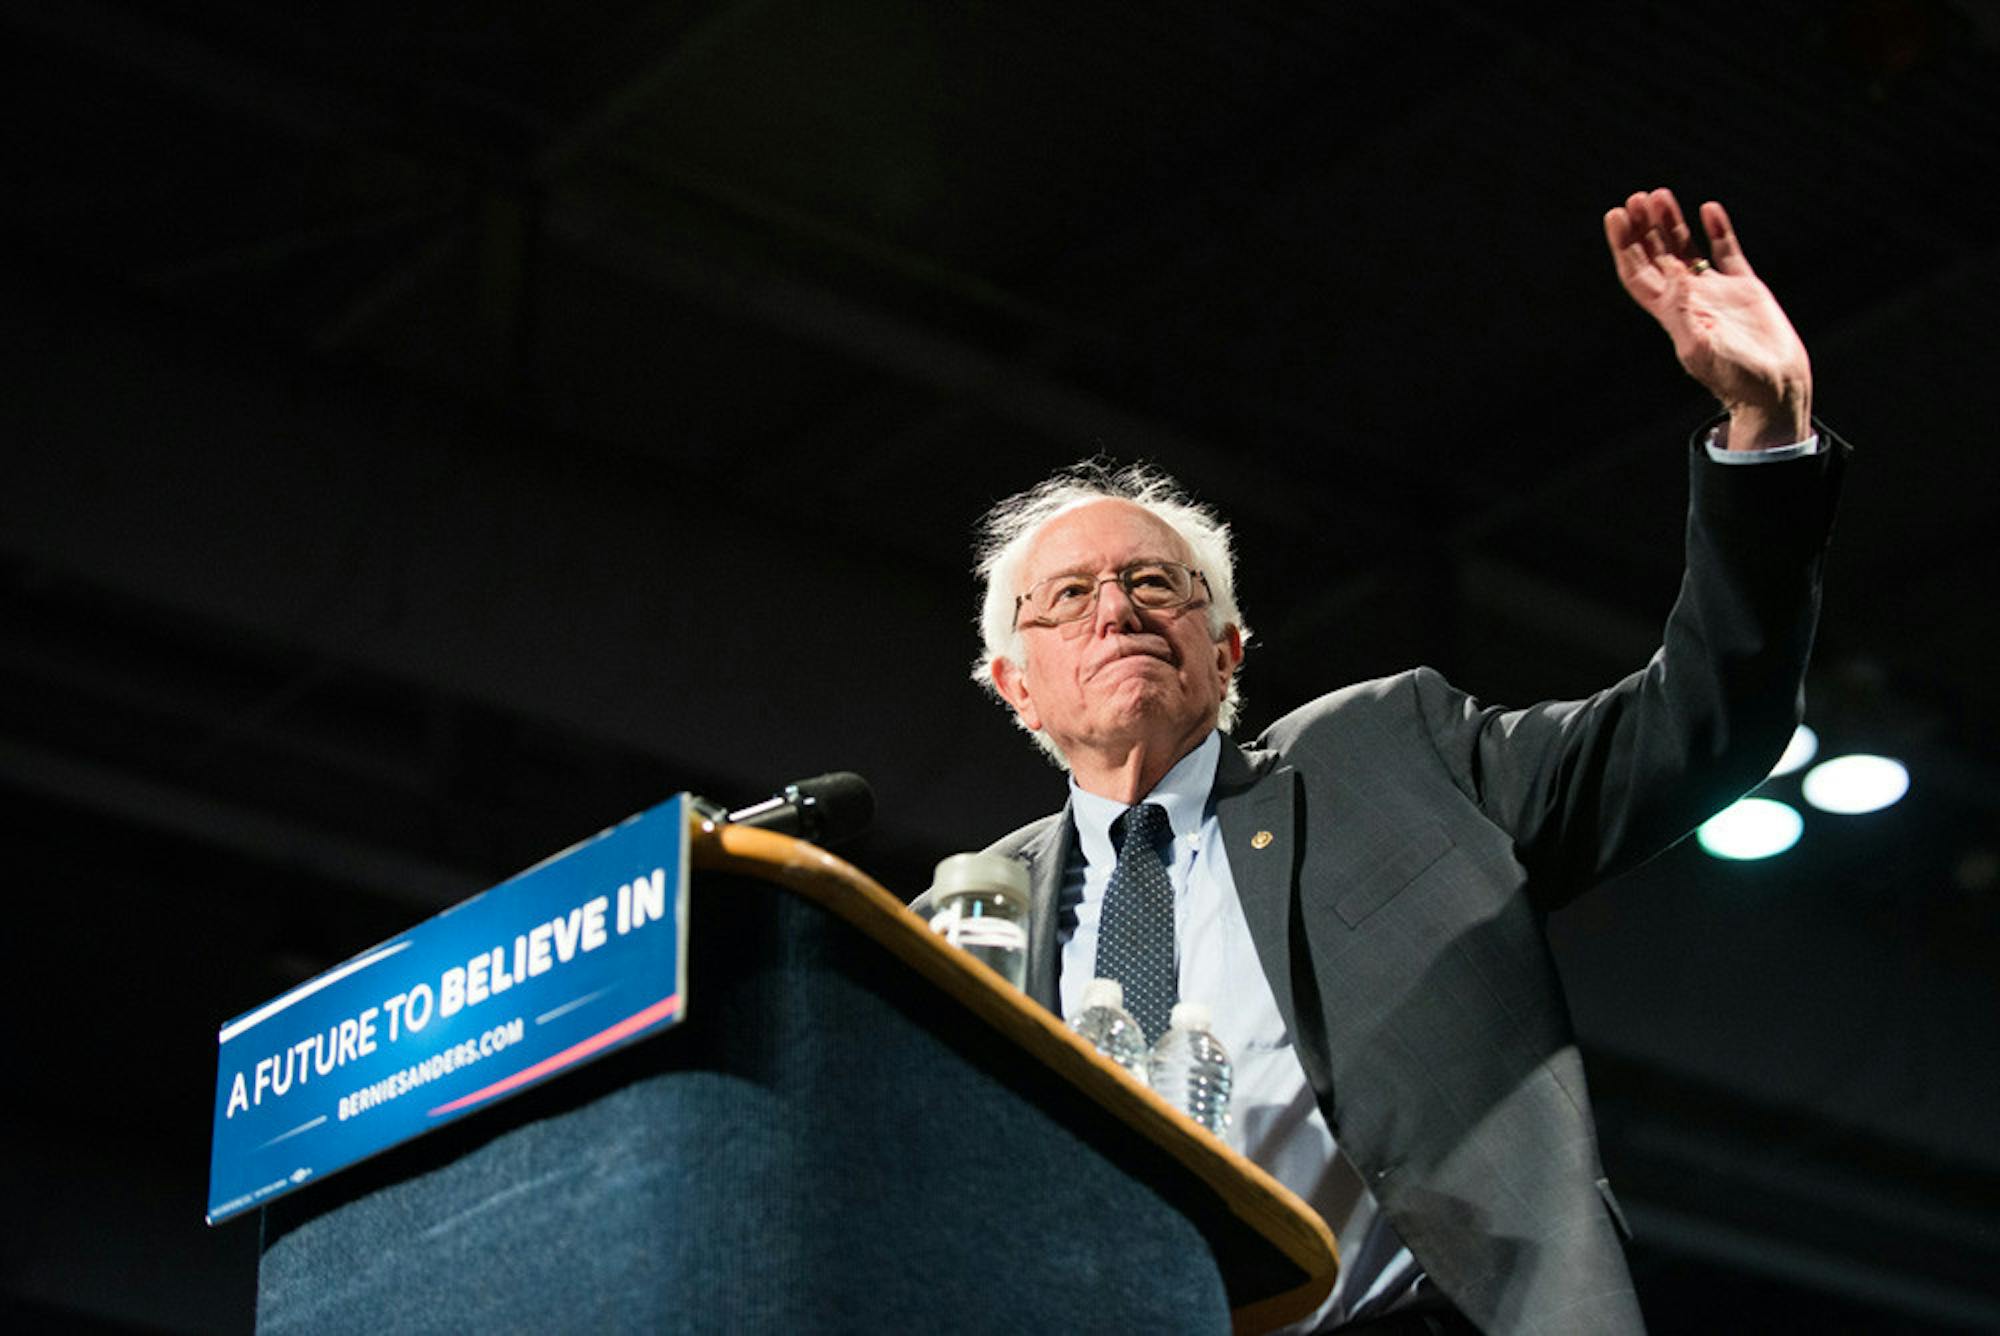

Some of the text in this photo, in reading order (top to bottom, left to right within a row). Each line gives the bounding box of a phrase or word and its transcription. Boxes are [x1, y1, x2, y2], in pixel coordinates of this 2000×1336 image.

[226, 868, 666, 1119] A FUTURE TO BELIEVE IN
[337, 1017, 524, 1121] BERNIESANDERS.COM
